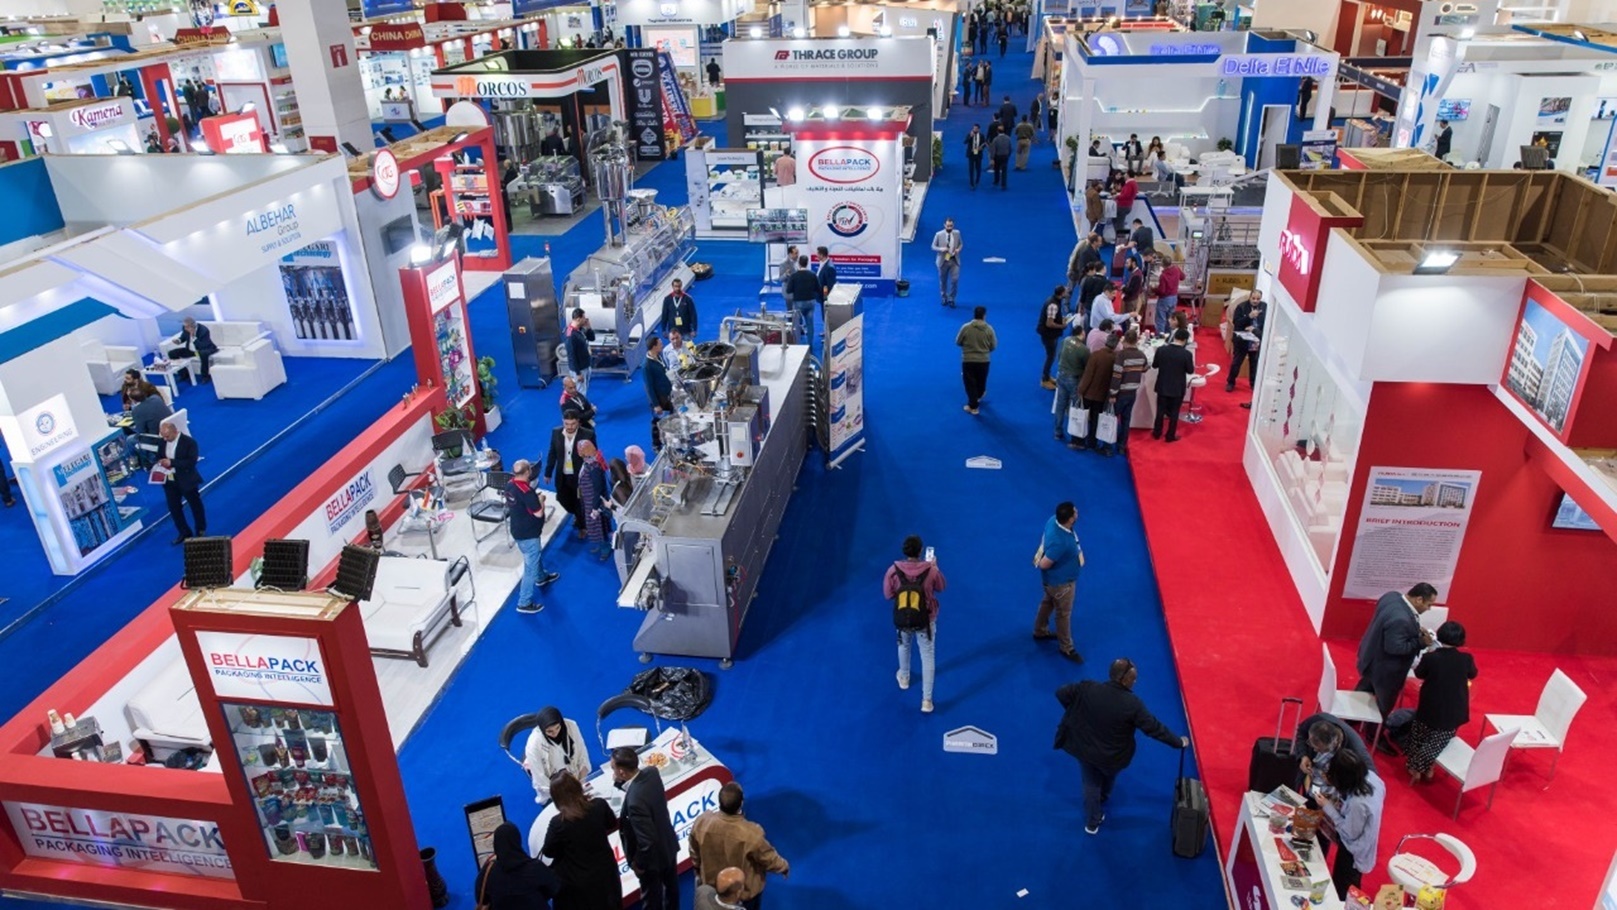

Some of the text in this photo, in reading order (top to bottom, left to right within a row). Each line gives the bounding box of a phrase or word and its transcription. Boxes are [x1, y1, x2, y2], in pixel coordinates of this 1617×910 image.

[371, 31, 404, 41] CHINA
[792, 48, 879, 60] THRACE GROUP
[1223, 57, 1330, 74] Delta El Nile
[456, 76, 527, 97] MORCOS
[70, 104, 123, 129] Kamena
[818, 158, 871, 166] BELLAPACK
[246, 204, 297, 236] ALBEHAR
[277, 221, 299, 236] Group
[325, 471, 372, 521] BELLAPACK
[1391, 519, 1460, 527] INTRODUCTION
[210, 652, 320, 674] BELLAPACK
[215, 669, 323, 685] PACKAGING INTELLIGENCE
[20, 807, 226, 850] BELLAPACK
[35, 838, 233, 870] PACKAGING INTELLIGENCE
